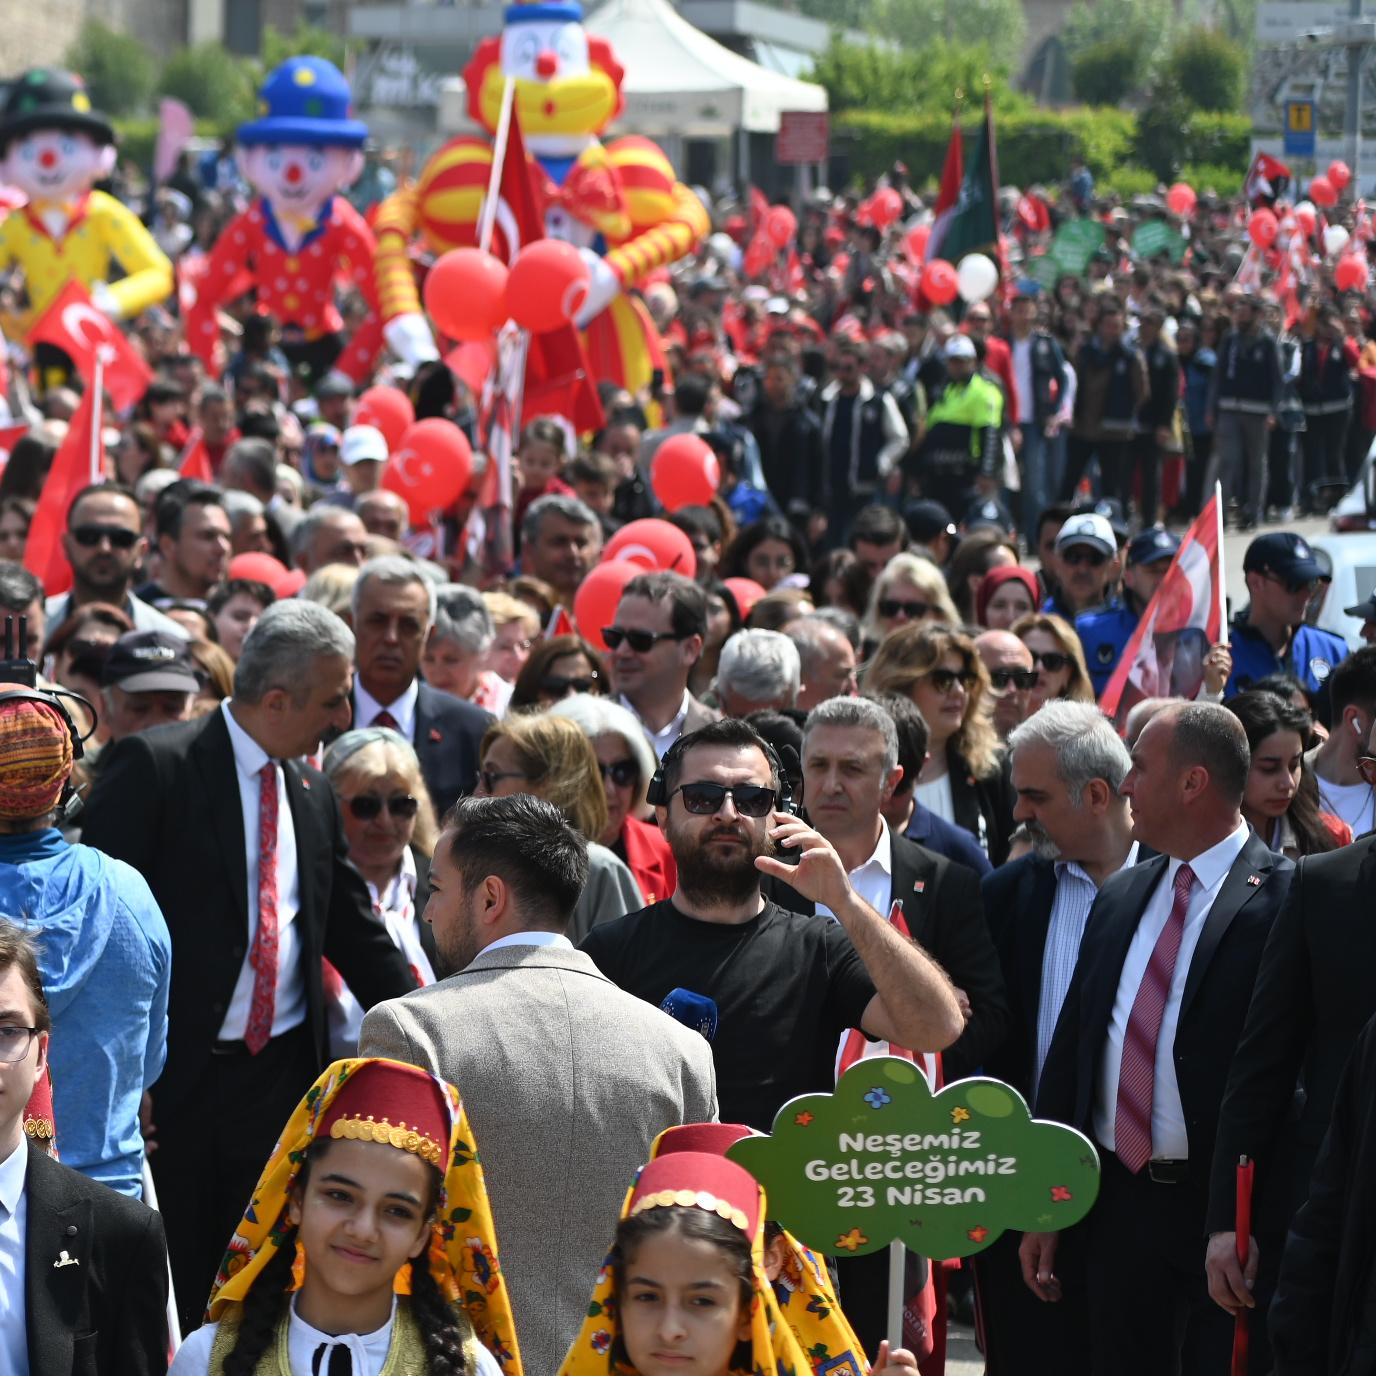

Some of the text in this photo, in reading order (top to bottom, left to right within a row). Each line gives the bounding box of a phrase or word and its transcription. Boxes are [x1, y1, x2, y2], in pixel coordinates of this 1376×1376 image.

[838, 1127, 981, 1157] Neşemiz
[804, 1154, 1017, 1184] Geleceğimiz
[836, 1184, 986, 1208] 23 Nisan
